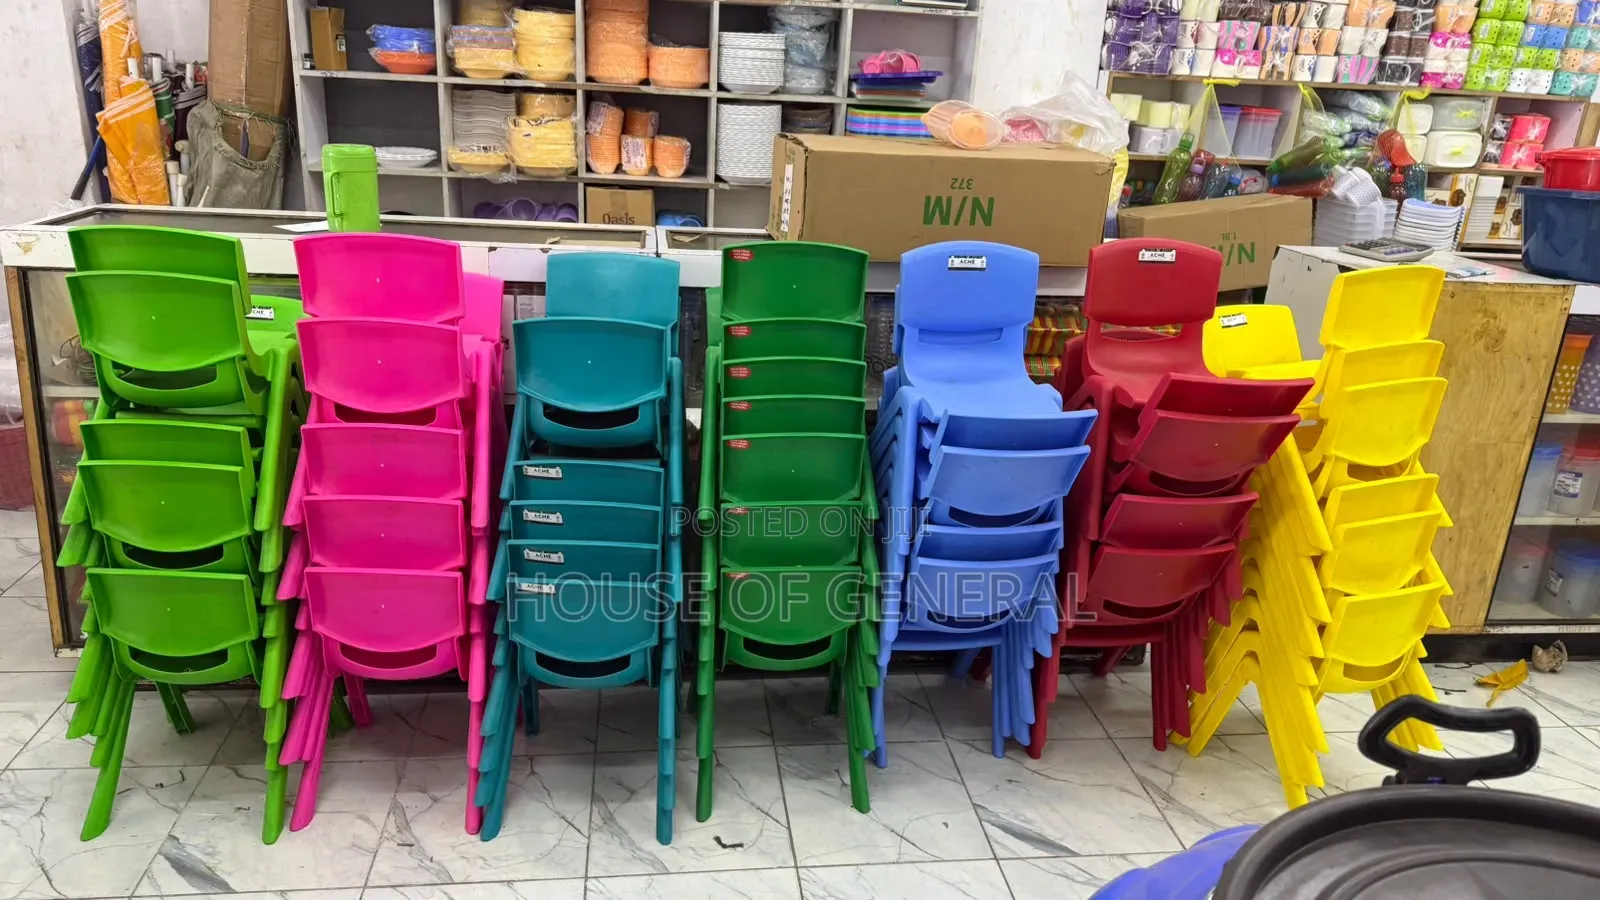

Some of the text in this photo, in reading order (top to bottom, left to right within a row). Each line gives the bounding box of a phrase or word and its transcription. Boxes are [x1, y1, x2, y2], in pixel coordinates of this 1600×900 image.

[950, 177, 974, 190] 372
[602, 212, 635, 225] Oasis
[922, 195, 995, 227] N/M
[1210, 241, 1256, 267] N/
